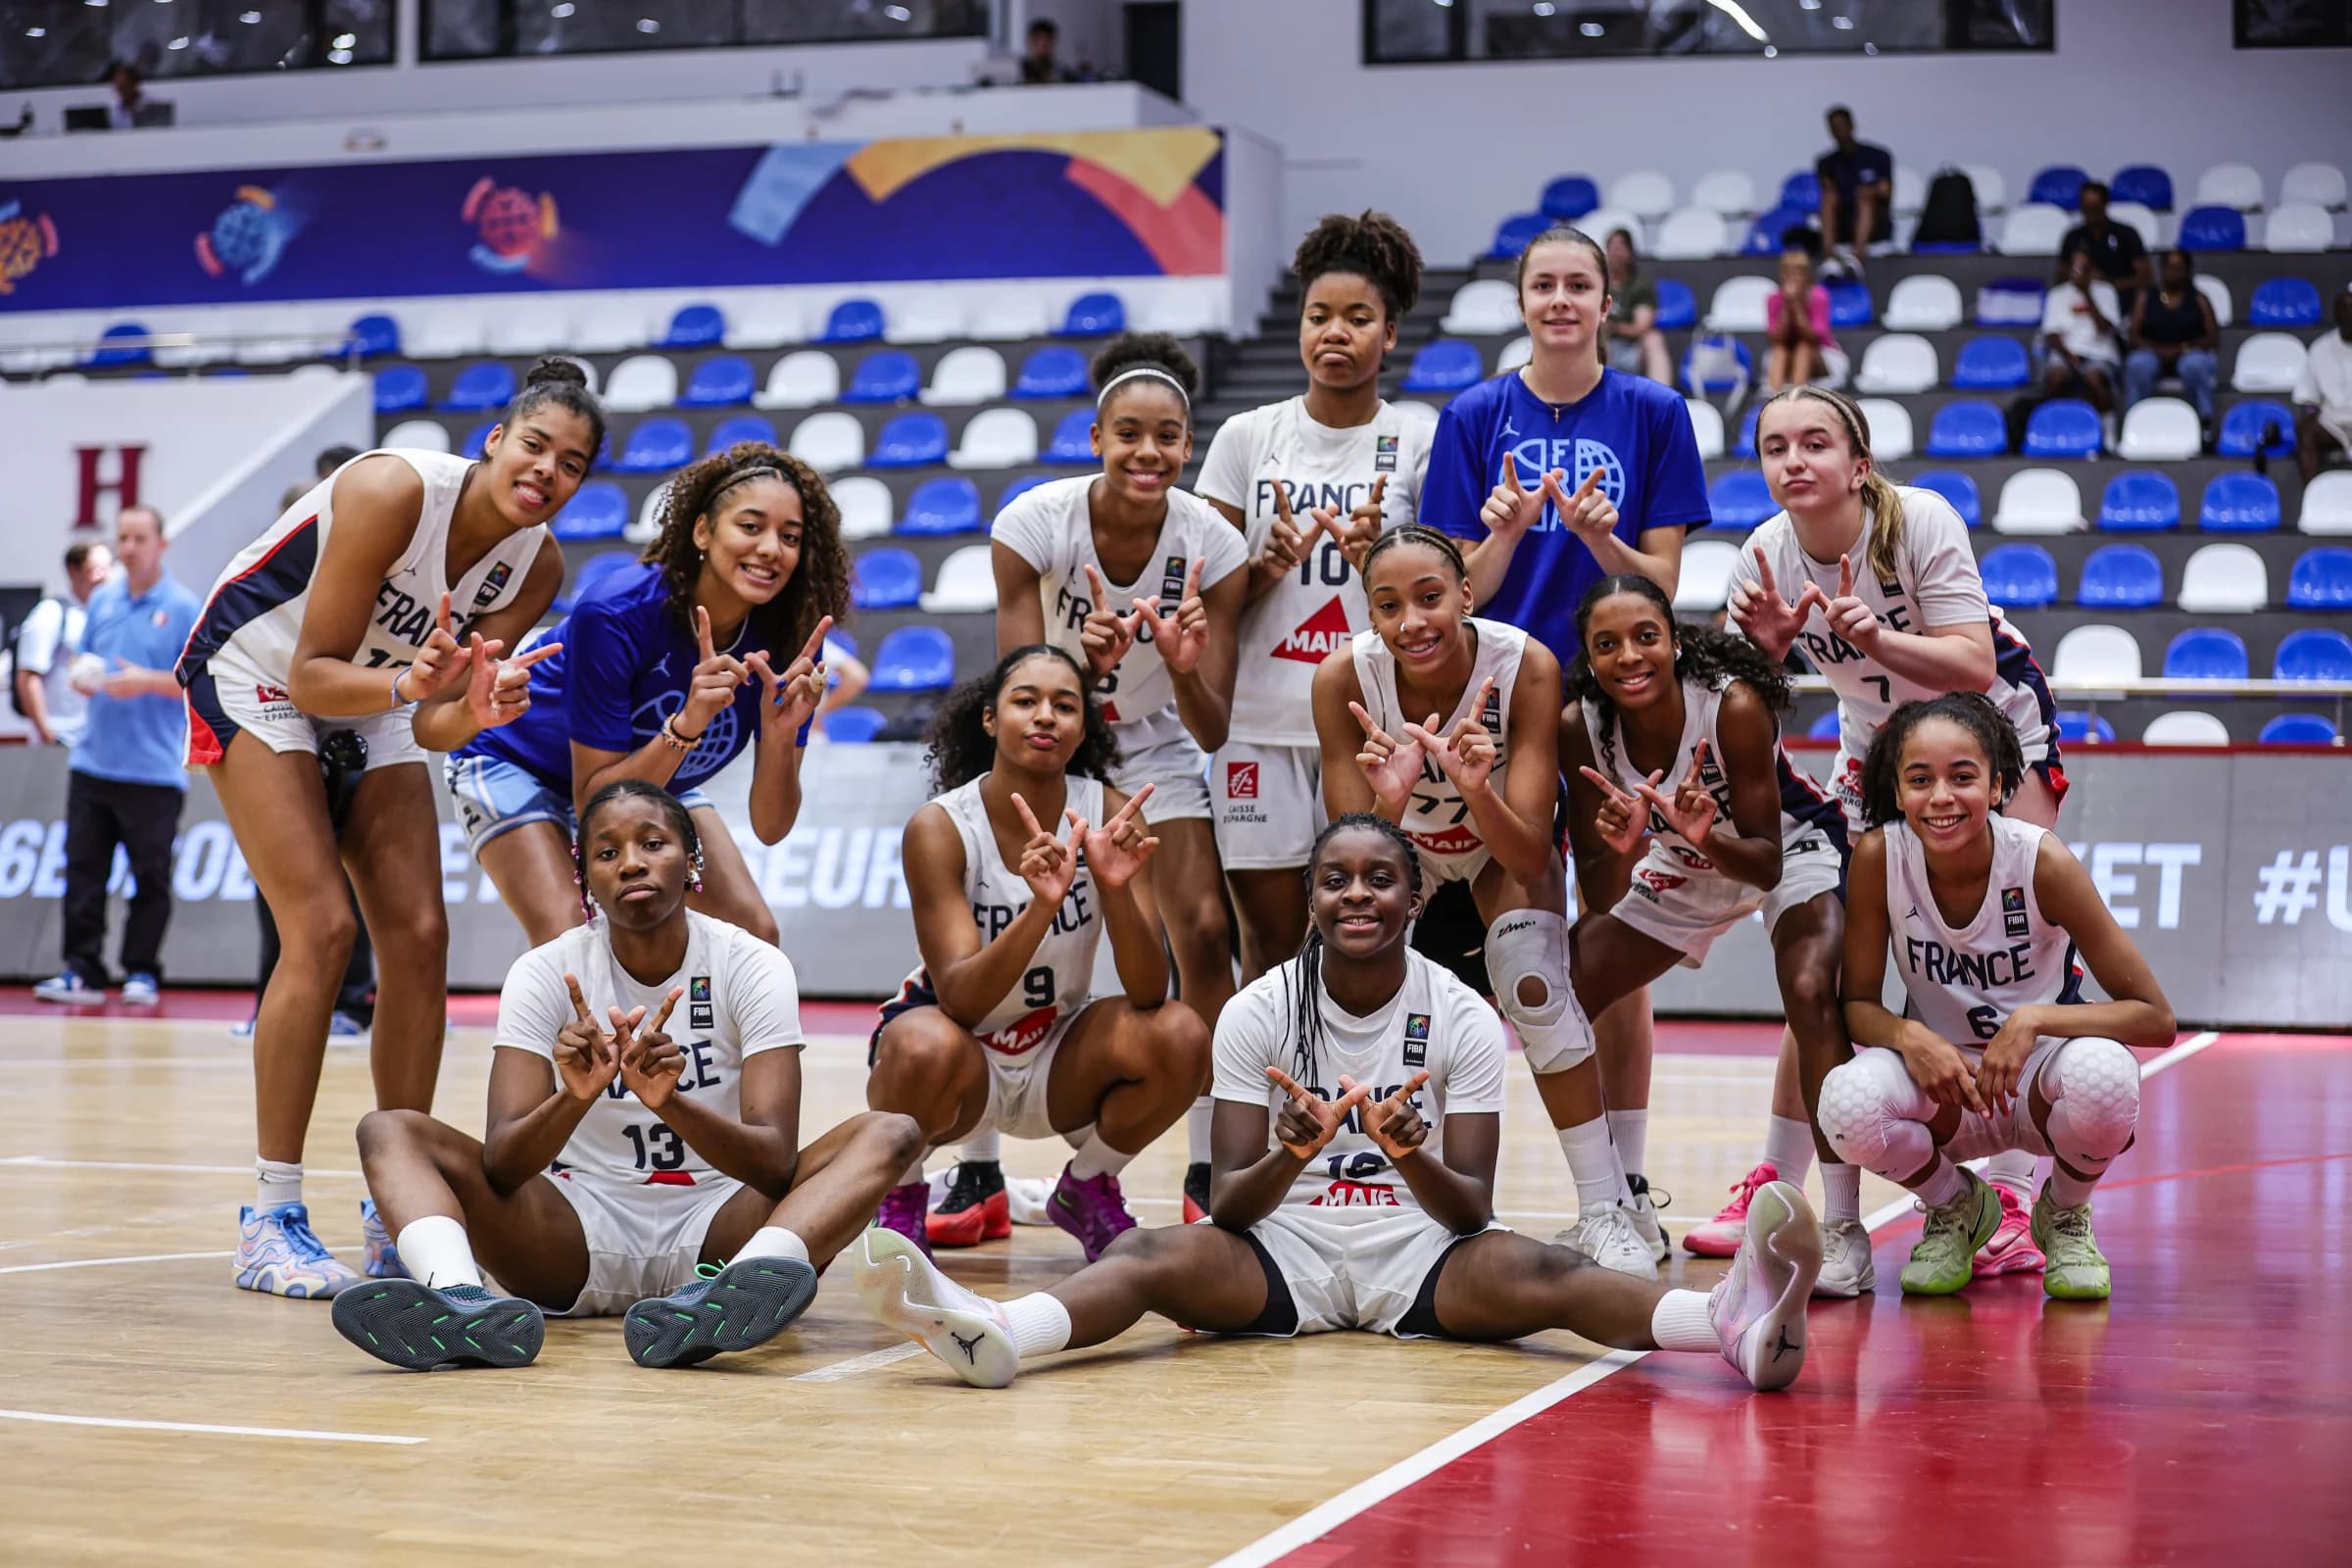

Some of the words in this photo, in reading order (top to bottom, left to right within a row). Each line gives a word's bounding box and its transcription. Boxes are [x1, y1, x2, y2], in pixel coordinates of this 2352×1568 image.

[73, 444, 148, 529] H
[1301, 541, 1350, 586] 10
[1285, 630, 1352, 653] MAIF
[1860, 674, 1890, 703] 7
[2007, 915, 2025, 925] FIBA
[1907, 936, 2035, 992] FRANCE
[1024, 965, 1055, 1008] 9
[694, 1006, 710, 1016] FIBA
[1966, 1004, 2001, 1040] 6
[1406, 1044, 1424, 1054] FIBA
[621, 1123, 685, 1170] 13
[1324, 1188, 1395, 1206] MAIF
